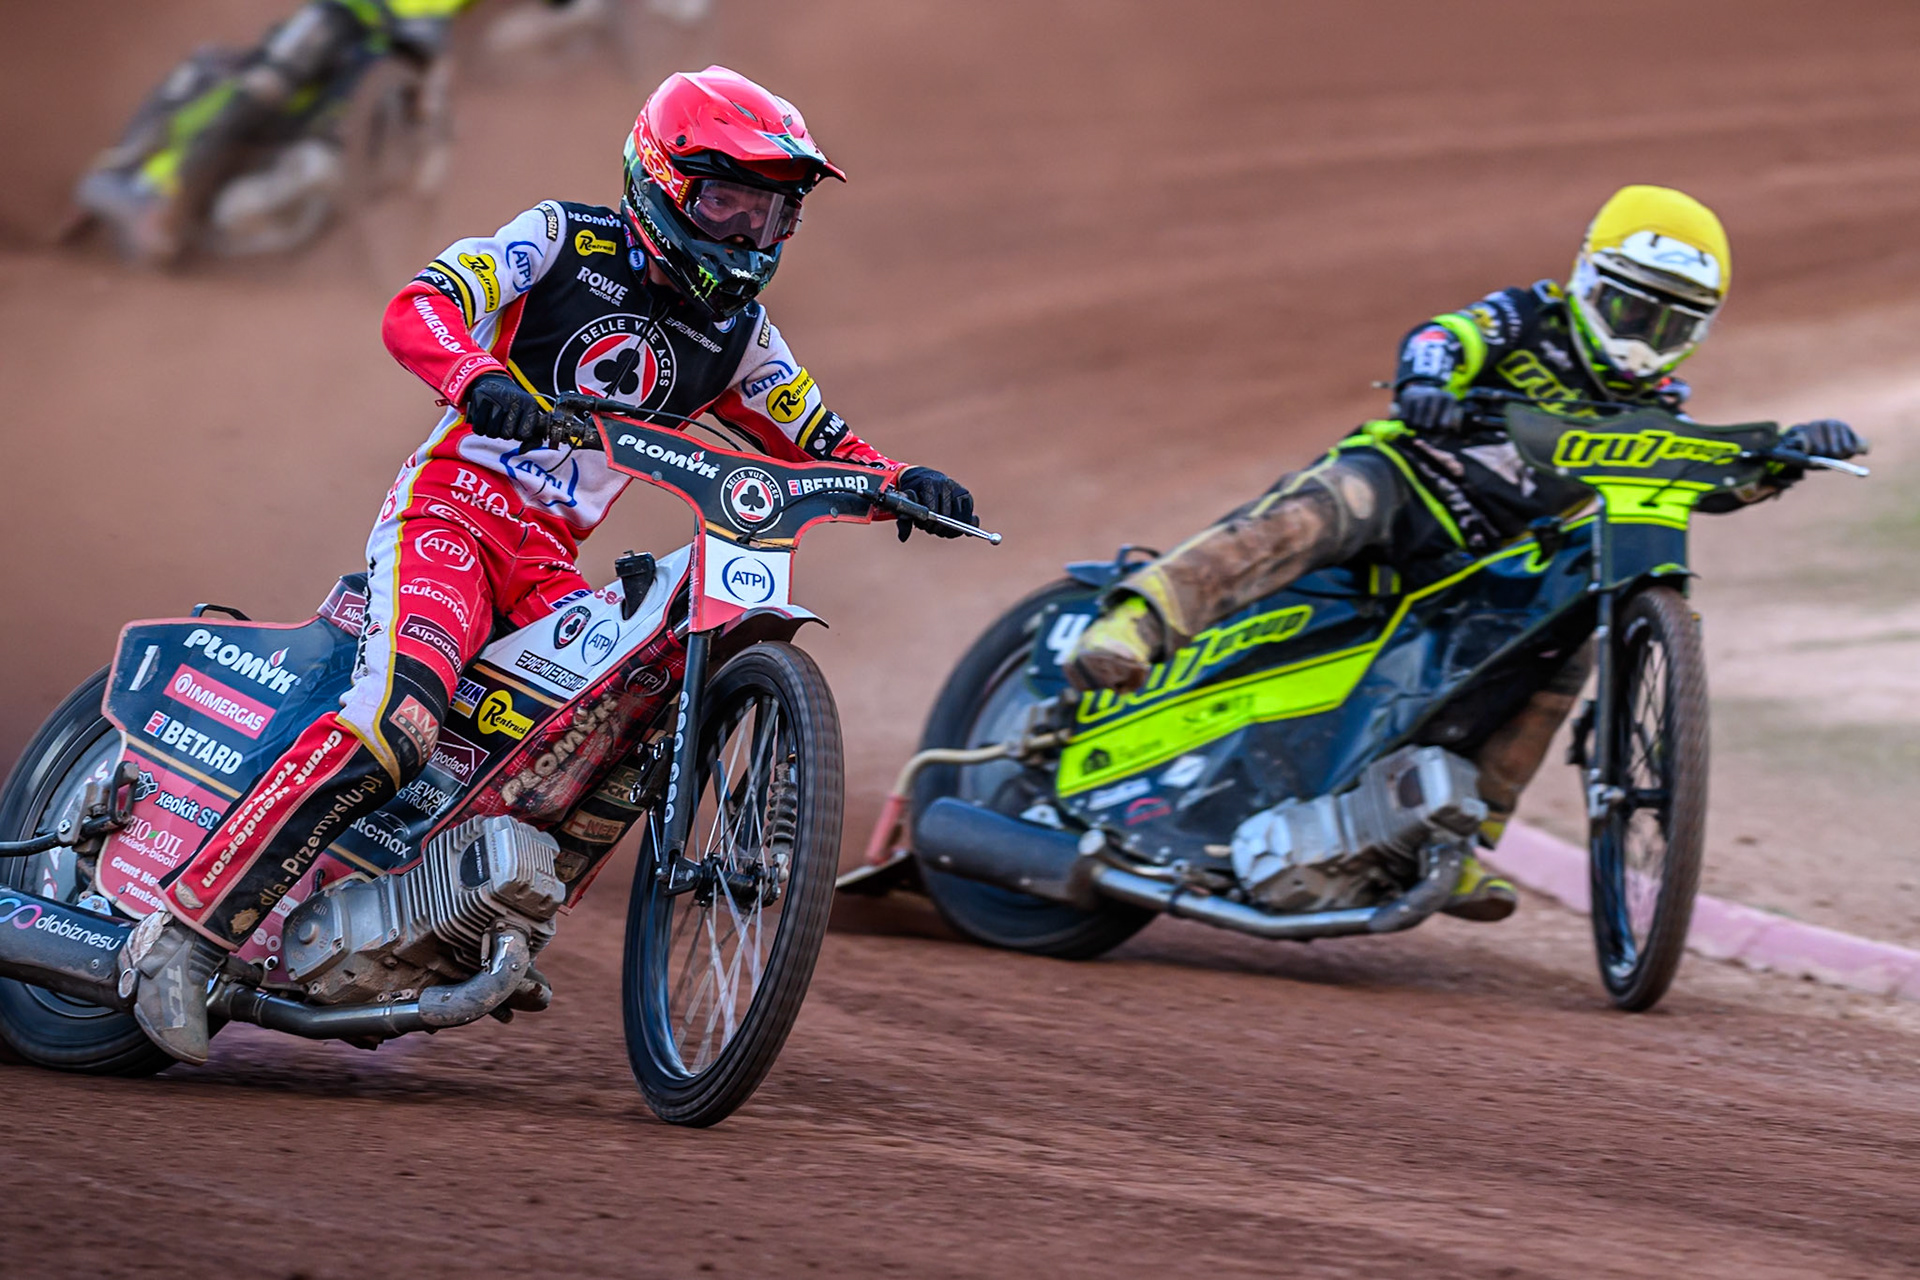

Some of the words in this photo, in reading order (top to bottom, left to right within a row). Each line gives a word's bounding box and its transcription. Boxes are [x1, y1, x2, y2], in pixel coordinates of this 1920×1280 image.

[576, 266, 629, 300] ROWE
[589, 287, 612, 302] MOTOR
[581, 319, 625, 345] BELLE
[656, 348, 670, 387] ACES
[750, 369, 787, 396] ATPI
[1554, 430, 1671, 467] tru7
[726, 471, 746, 490] BELLE
[748, 471, 765, 481] VUE
[765, 480, 780, 499] ACES
[801, 475, 869, 495] BETARD
[423, 536, 469, 563] ATPI
[731, 570, 766, 589] ATPI
[400, 584, 470, 633] automax
[407, 625, 464, 674] Alpodach
[588, 633, 613, 653] ATPI
[129, 645, 159, 691] 1
[522, 652, 588, 690] PREMIERSHIP
[633, 671, 662, 691] ATPI
[187, 685, 265, 731] IMMERGAS
[482, 698, 528, 735] Rentruck
[161, 720, 243, 775] BETARD
[294, 730, 343, 785] Grant
[430, 747, 470, 777] lpodach
[155, 791, 200, 822] xeokit
[228, 761, 298, 836] Tankers
[154, 829, 184, 859] OIL
[201, 787, 290, 888] Henderson
[111, 856, 140, 879] Grant
[35, 914, 121, 950] dlabiznesu
